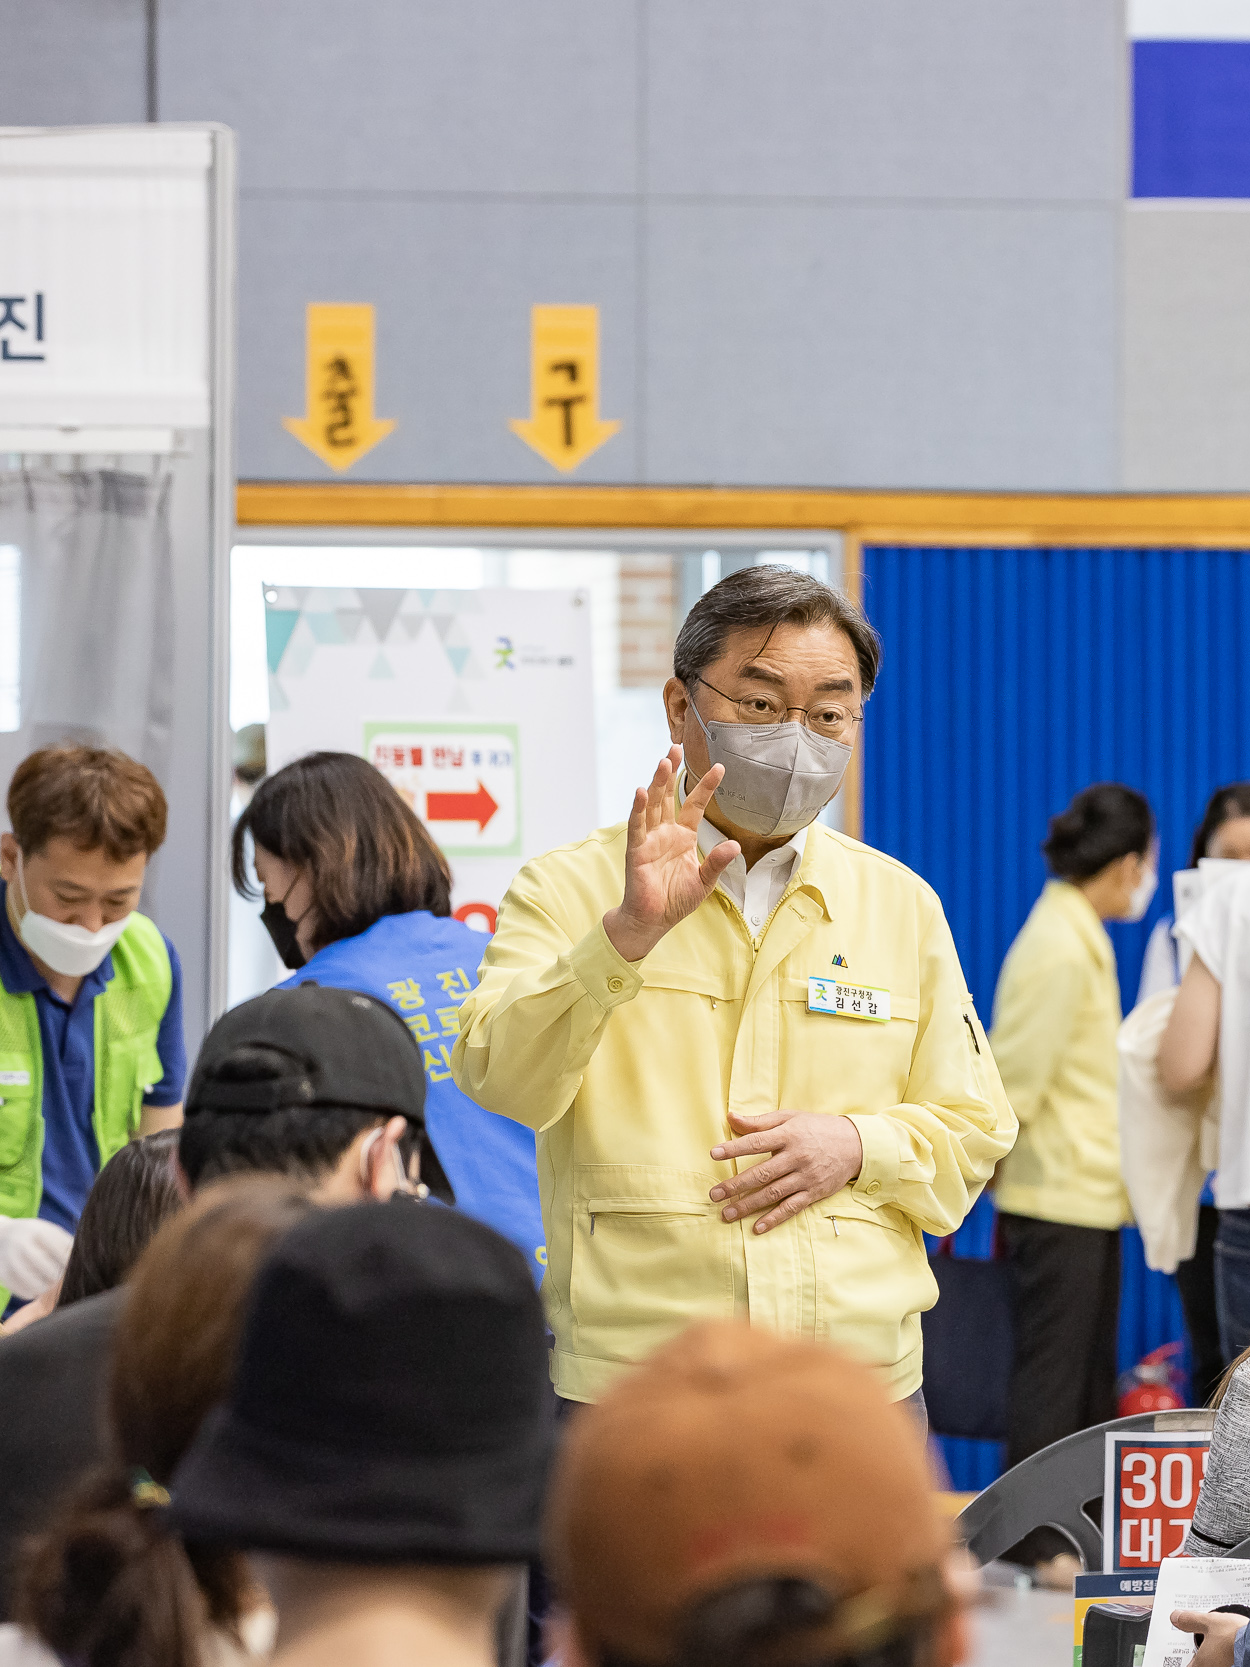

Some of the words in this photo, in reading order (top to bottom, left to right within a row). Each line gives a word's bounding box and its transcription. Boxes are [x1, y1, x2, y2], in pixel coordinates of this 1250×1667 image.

[544, 359, 587, 450] 구
[836, 986, 872, 1000] 광진구청장
[1119, 1579, 1158, 1592] 예방접
